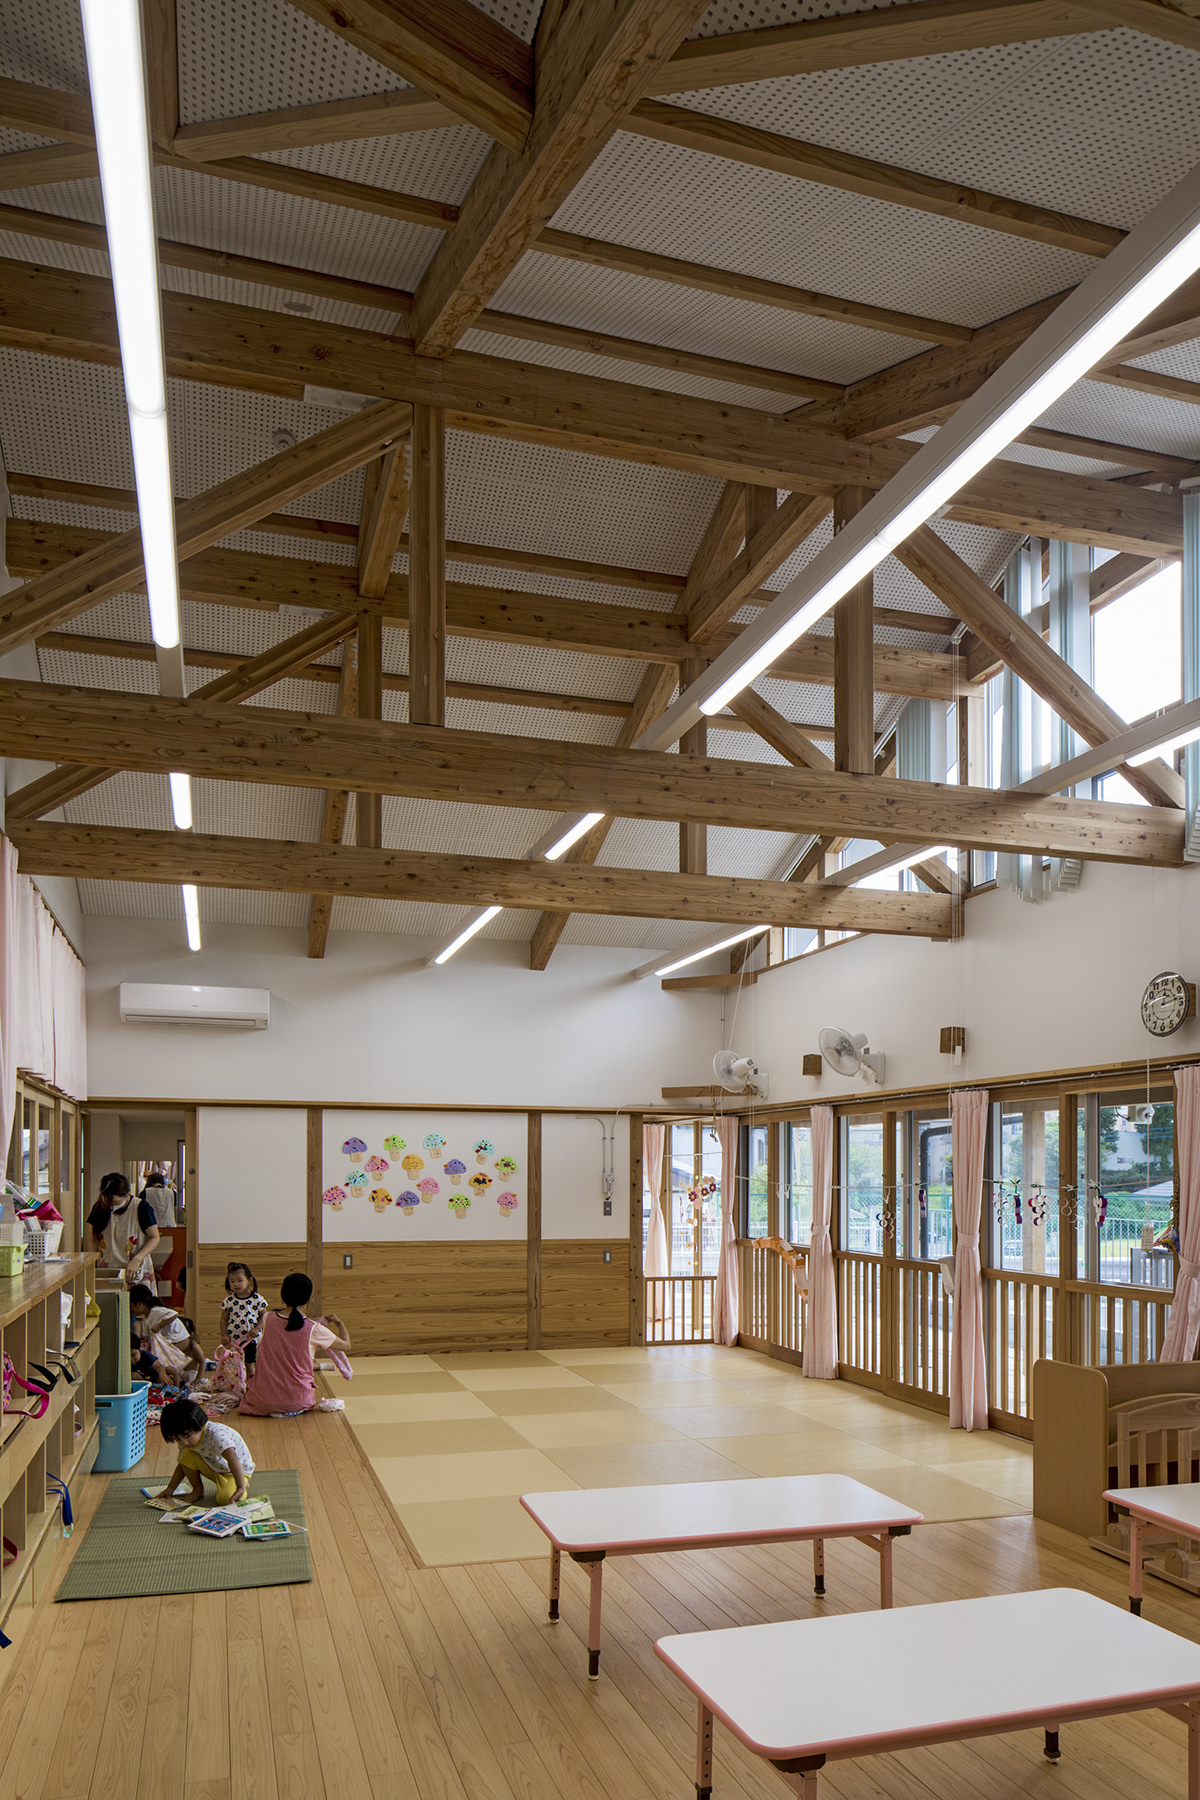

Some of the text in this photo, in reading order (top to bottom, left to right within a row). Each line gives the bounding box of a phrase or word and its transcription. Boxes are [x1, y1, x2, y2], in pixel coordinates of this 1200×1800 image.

[1153, 982, 1159, 990] 11
[1161, 978, 1169, 986] 12
[1171, 979, 1175, 988] 1
[1178, 998, 1184, 1006] 3
[1176, 1010, 1181, 1018] 4
[1153, 1021, 1157, 1030] 7
[1160, 1022, 1165, 1031] 6
[1169, 1020, 1174, 1028] 5
